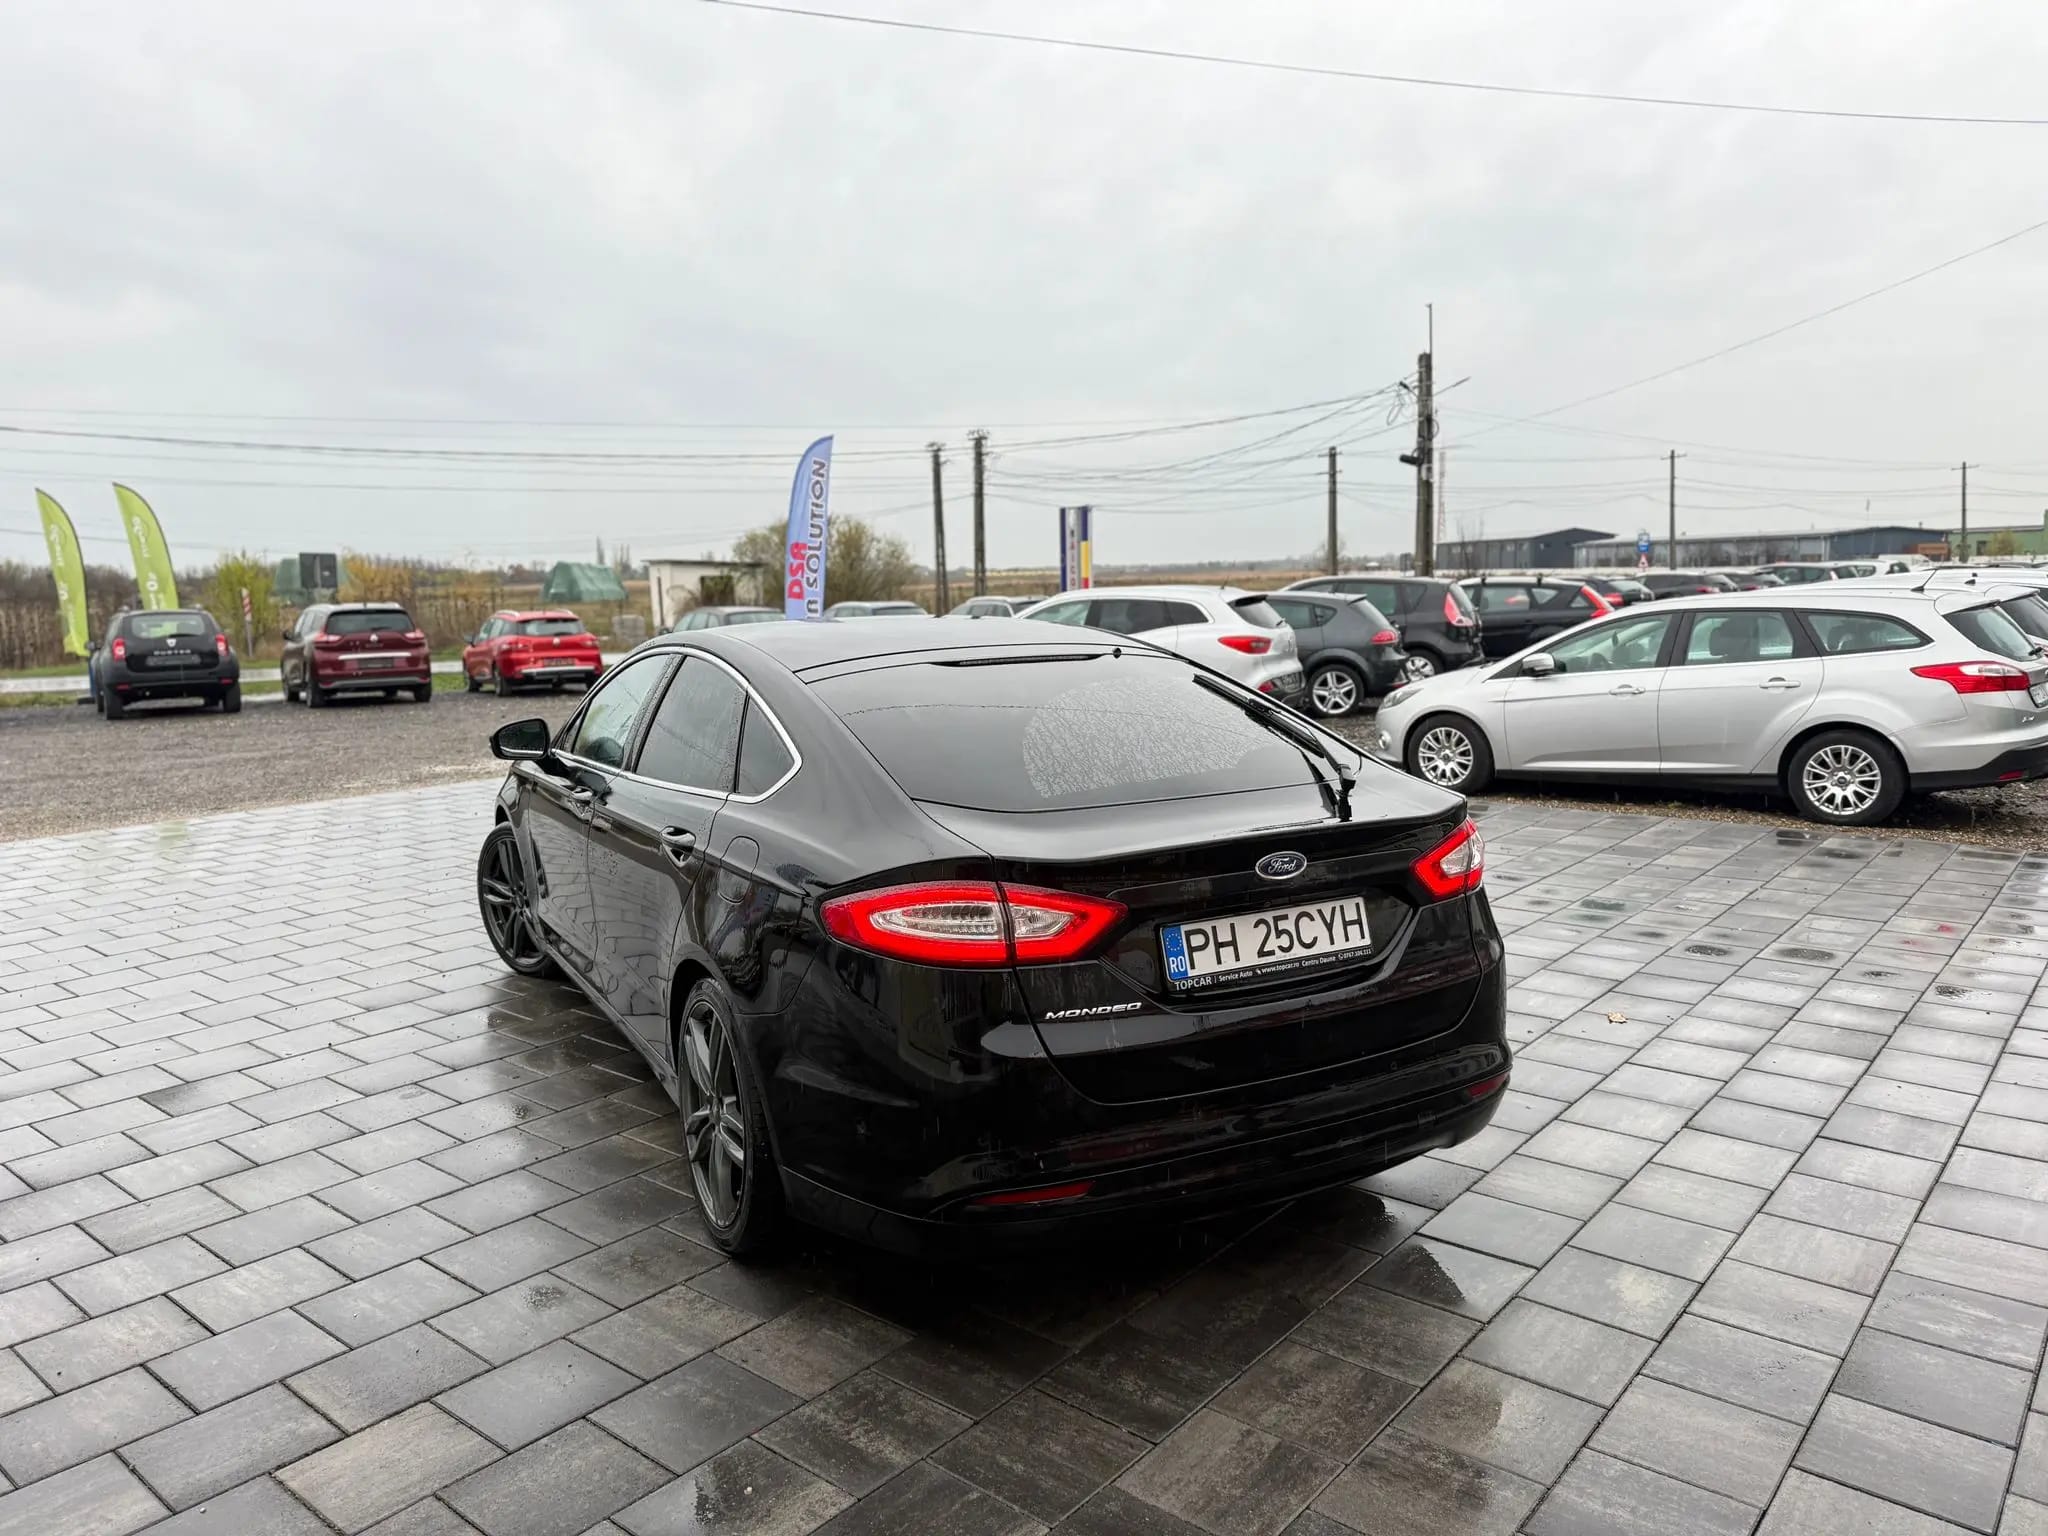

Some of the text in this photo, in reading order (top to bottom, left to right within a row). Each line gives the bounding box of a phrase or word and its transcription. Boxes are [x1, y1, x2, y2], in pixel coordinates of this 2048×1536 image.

[806, 460, 826, 590] SOLUTION
[1185, 902, 1366, 970] PH 25CYH
[1169, 956, 1186, 973] RO
[1174, 976, 1212, 991] TOPCAR
[1218, 973, 1239, 982] Service
[1240, 970, 1253, 978] Auto
[1261, 962, 1299, 974] www.topcar.ro
[1044, 1001, 1142, 1020] MONDEO
